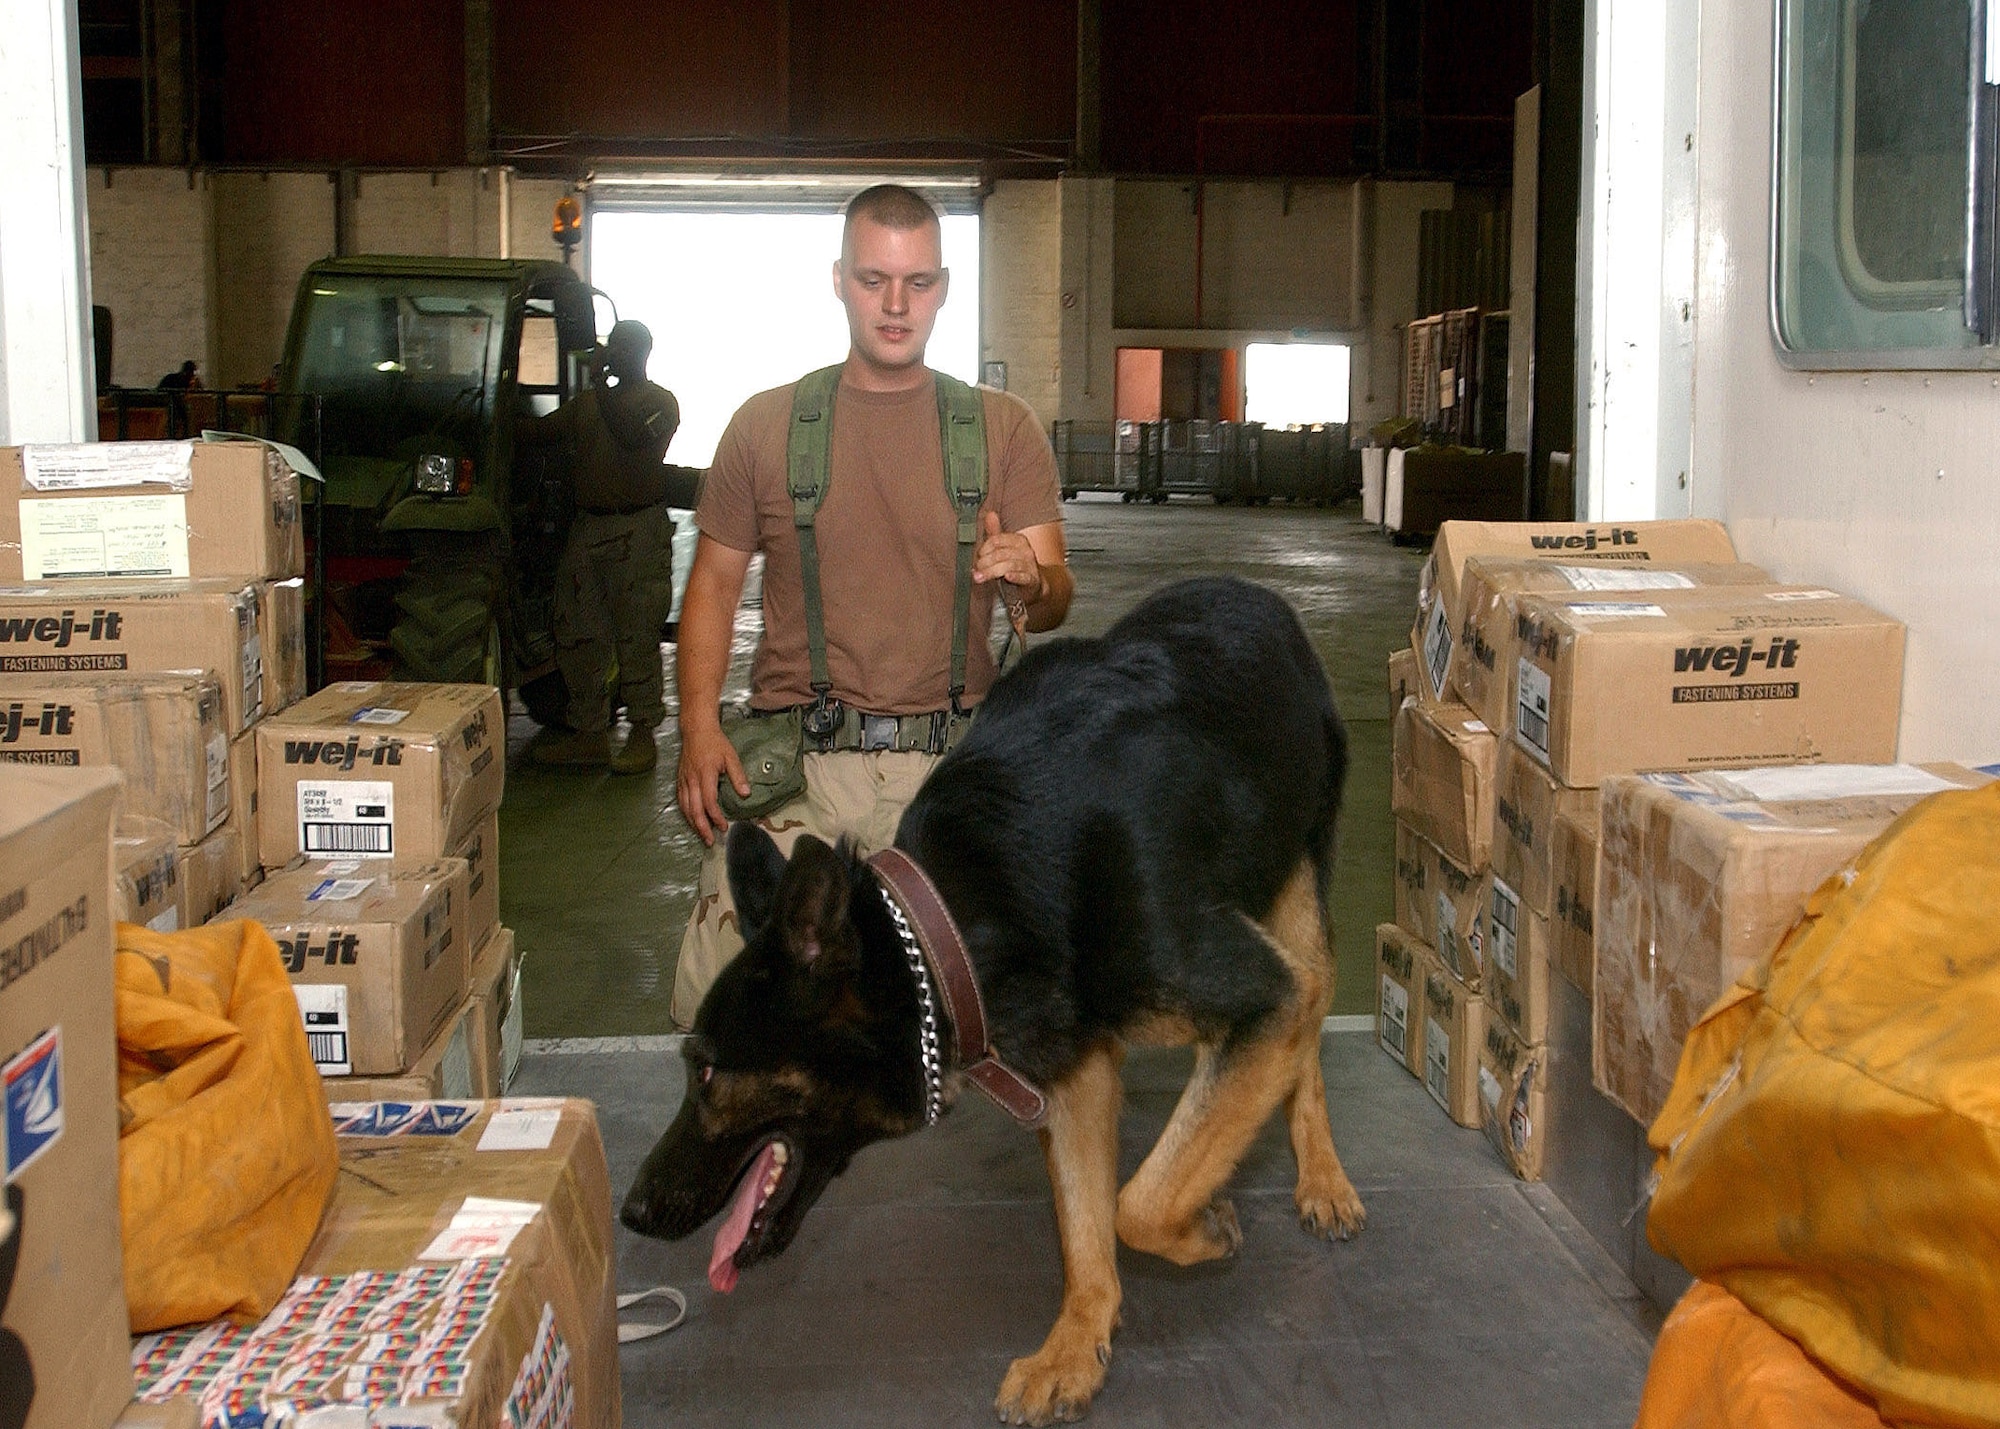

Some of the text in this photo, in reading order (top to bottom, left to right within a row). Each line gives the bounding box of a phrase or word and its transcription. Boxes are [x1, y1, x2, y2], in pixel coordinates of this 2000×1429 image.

[1531, 528, 1638, 550] wej-it
[0, 610, 123, 648] wej-it
[4, 656, 122, 671] FASTENING SYSTEMS
[1674, 637, 1801, 677] wej-it
[1678, 684, 1795, 701] FASTENING SYSTEMS
[0, 703, 75, 742] j-it
[17, 751, 74, 766] SYSTEMS
[284, 735, 405, 771] wej-it
[276, 931, 360, 973] ej-it
